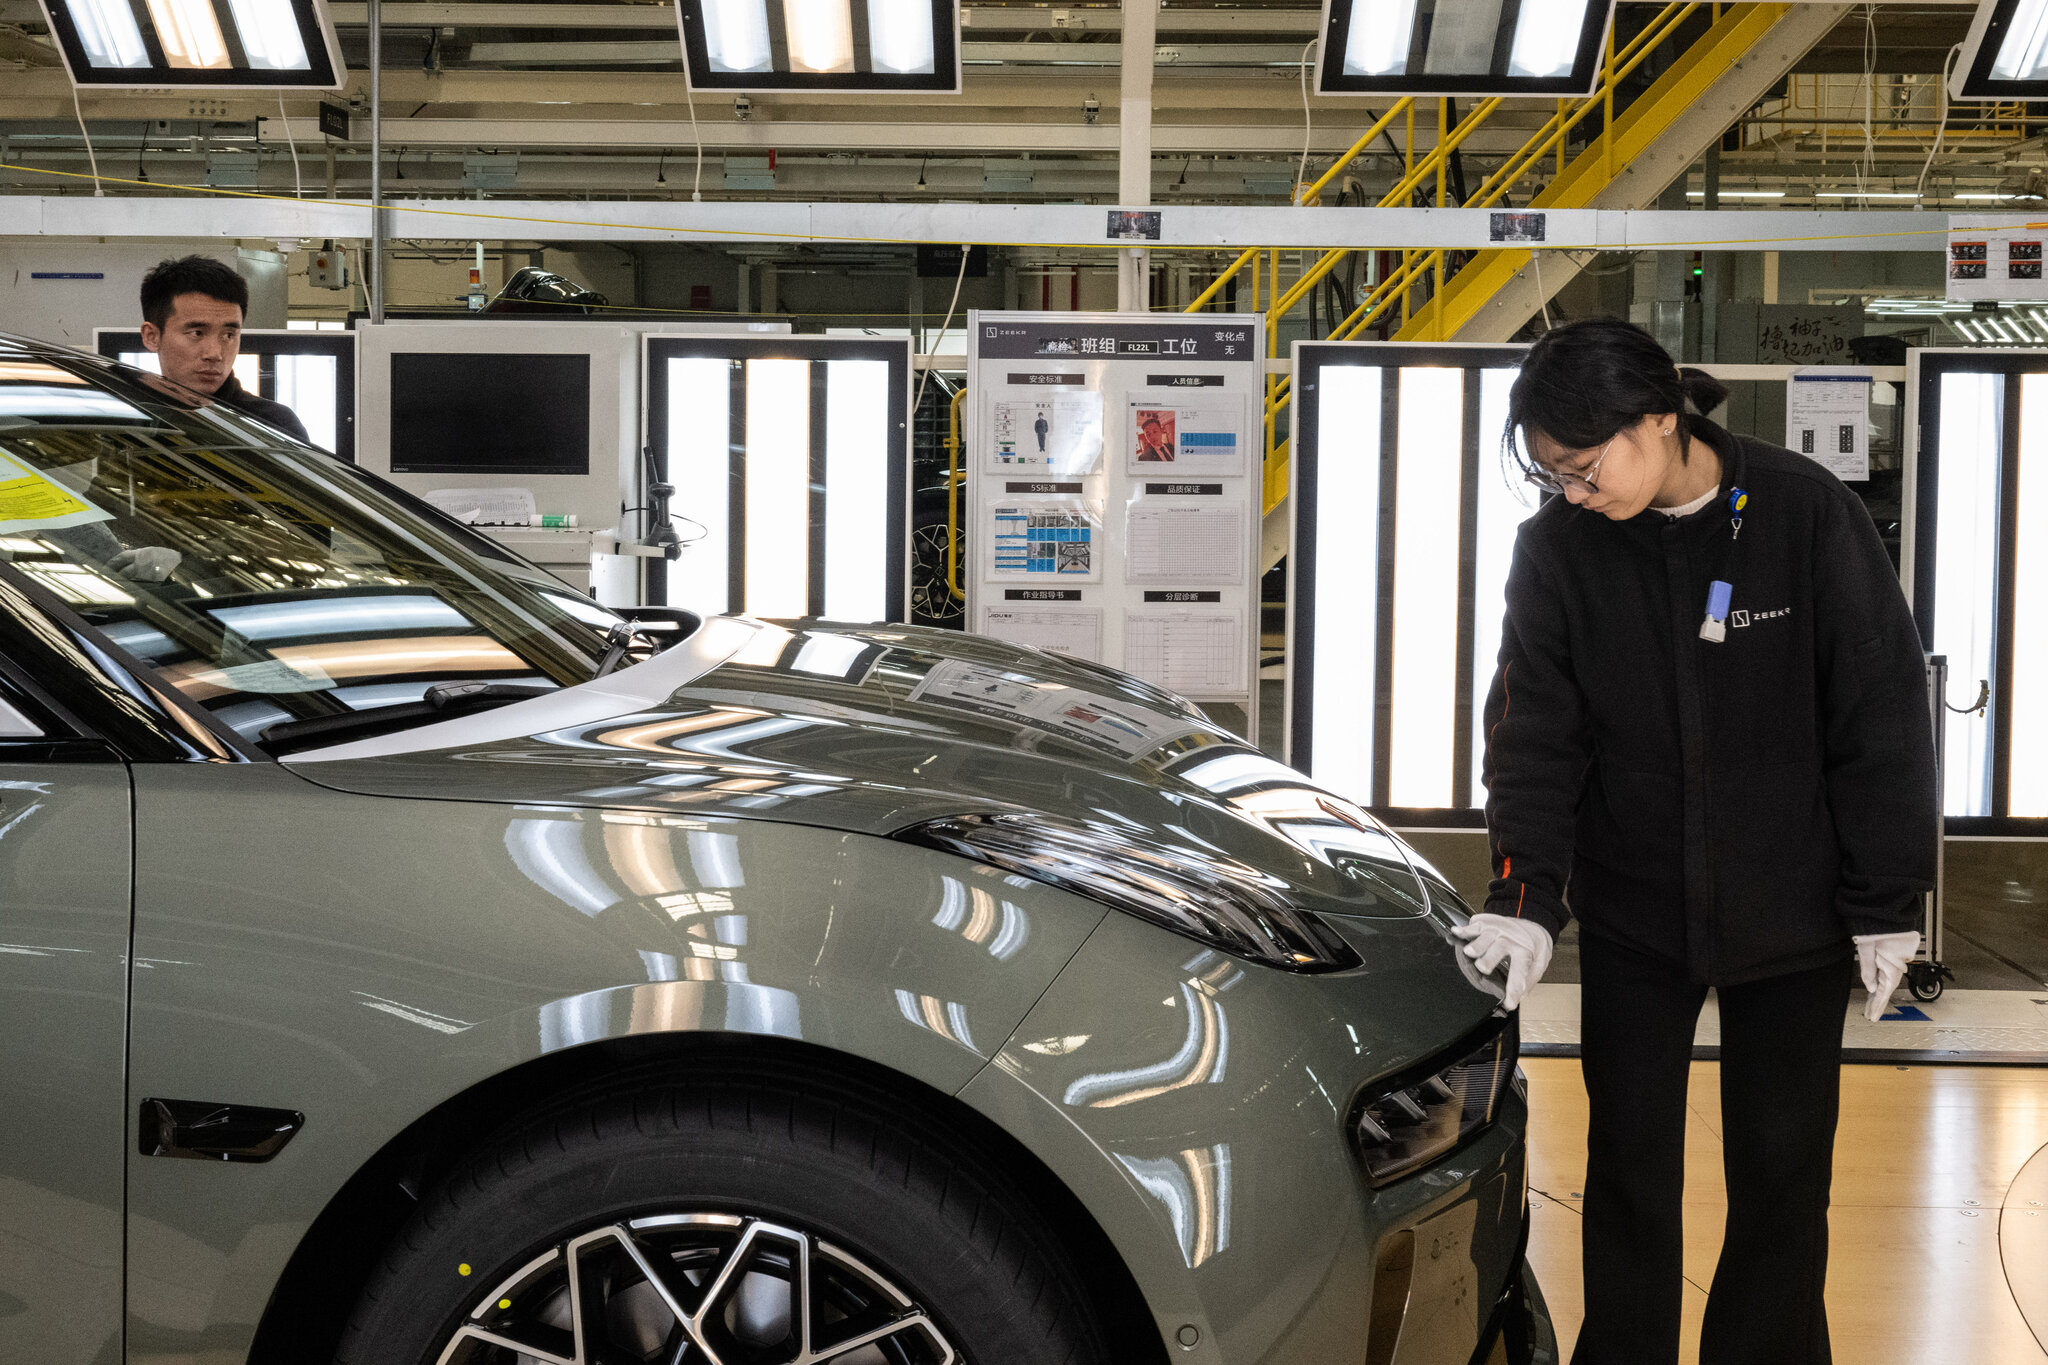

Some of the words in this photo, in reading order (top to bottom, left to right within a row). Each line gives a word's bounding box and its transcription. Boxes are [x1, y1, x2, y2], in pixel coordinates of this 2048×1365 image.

[1214, 331, 1245, 342] 变化点
[1081, 337, 1116, 354] 班组
[1127, 343, 1150, 351] FL22L
[1162, 338, 1198, 355] 工位
[1224, 345, 1235, 355] 无
[1029, 375, 1062, 384] 安全标准
[1172, 377, 1201, 385] 人员信息
[1031, 483, 1057, 492] 5S标准
[1167, 484, 1201, 494] 品质保证
[1022, 590, 1064, 600] 作业指导书
[1165, 592, 1199, 601] 分层诊断
[1753, 607, 1791, 620] ZEEKR
